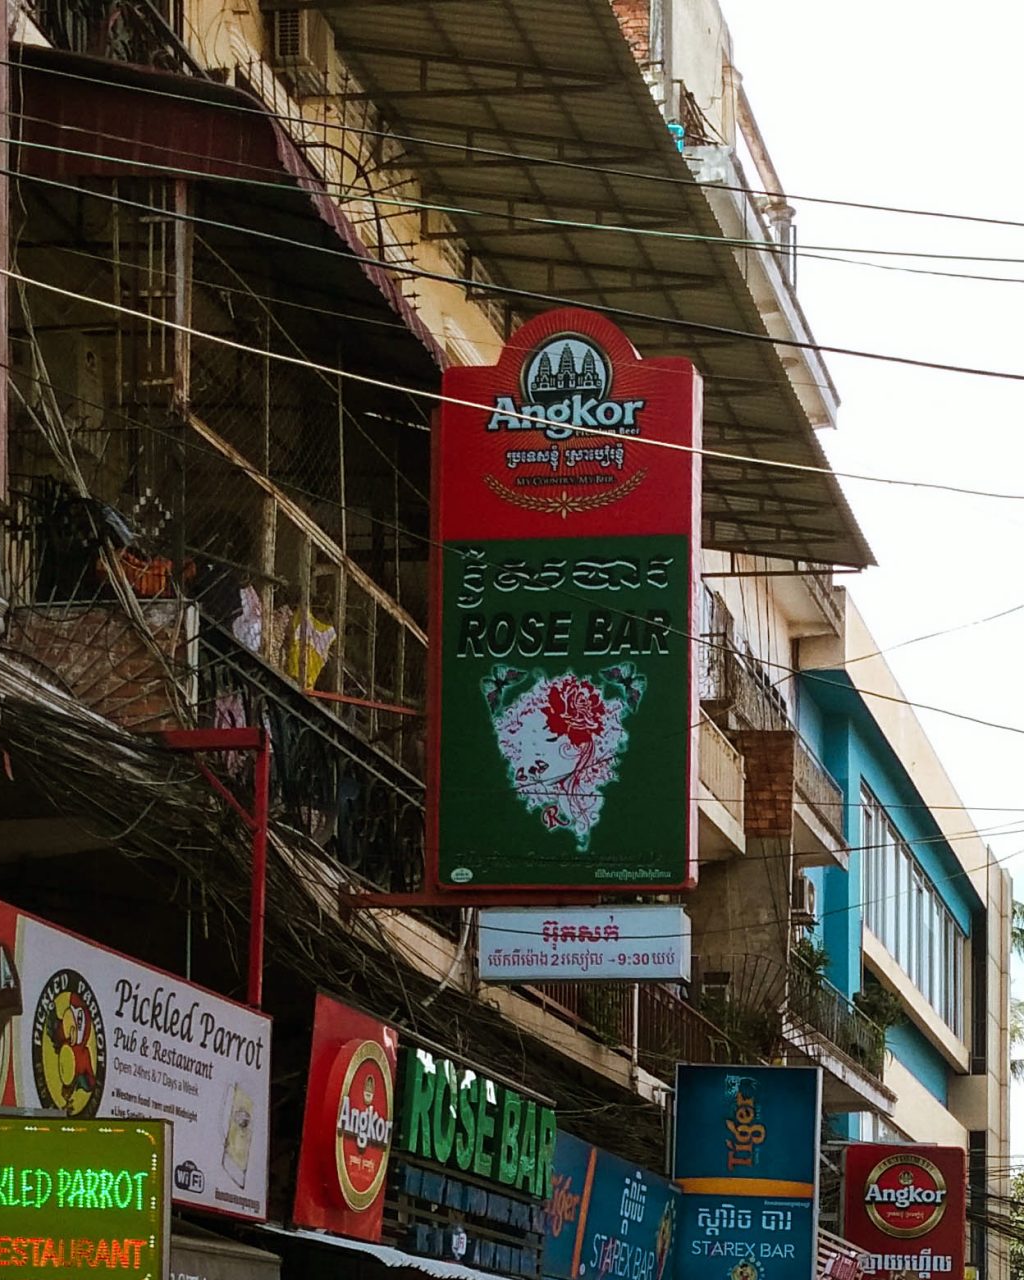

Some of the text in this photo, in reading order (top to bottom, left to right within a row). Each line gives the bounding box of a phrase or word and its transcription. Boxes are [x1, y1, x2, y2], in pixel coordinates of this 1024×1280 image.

[488, 394, 644, 439] Angkor
[457, 609, 673, 658] ROSE BAR
[34, 973, 105, 1067] PICKLED PARROT
[115, 980, 263, 1070] Pickled Parrot
[114, 1028, 214, 1080] Pub & Restaurant
[114, 1057, 132, 1076] Open
[133, 1063, 151, 1080] 24hrs
[157, 1070, 162, 1084] 7
[162, 1072, 177, 1091] Days
[337, 1096, 392, 1149] Angkor
[408, 1047, 558, 1200] ROSE BAR
[726, 1092, 766, 1172] Tiger
[57, 1169, 148, 1210] PARROT
[865, 1184, 947, 1208] Angkor
[590, 1233, 634, 1277] STAREX
[691, 1240, 795, 1258] STAREX BAR
